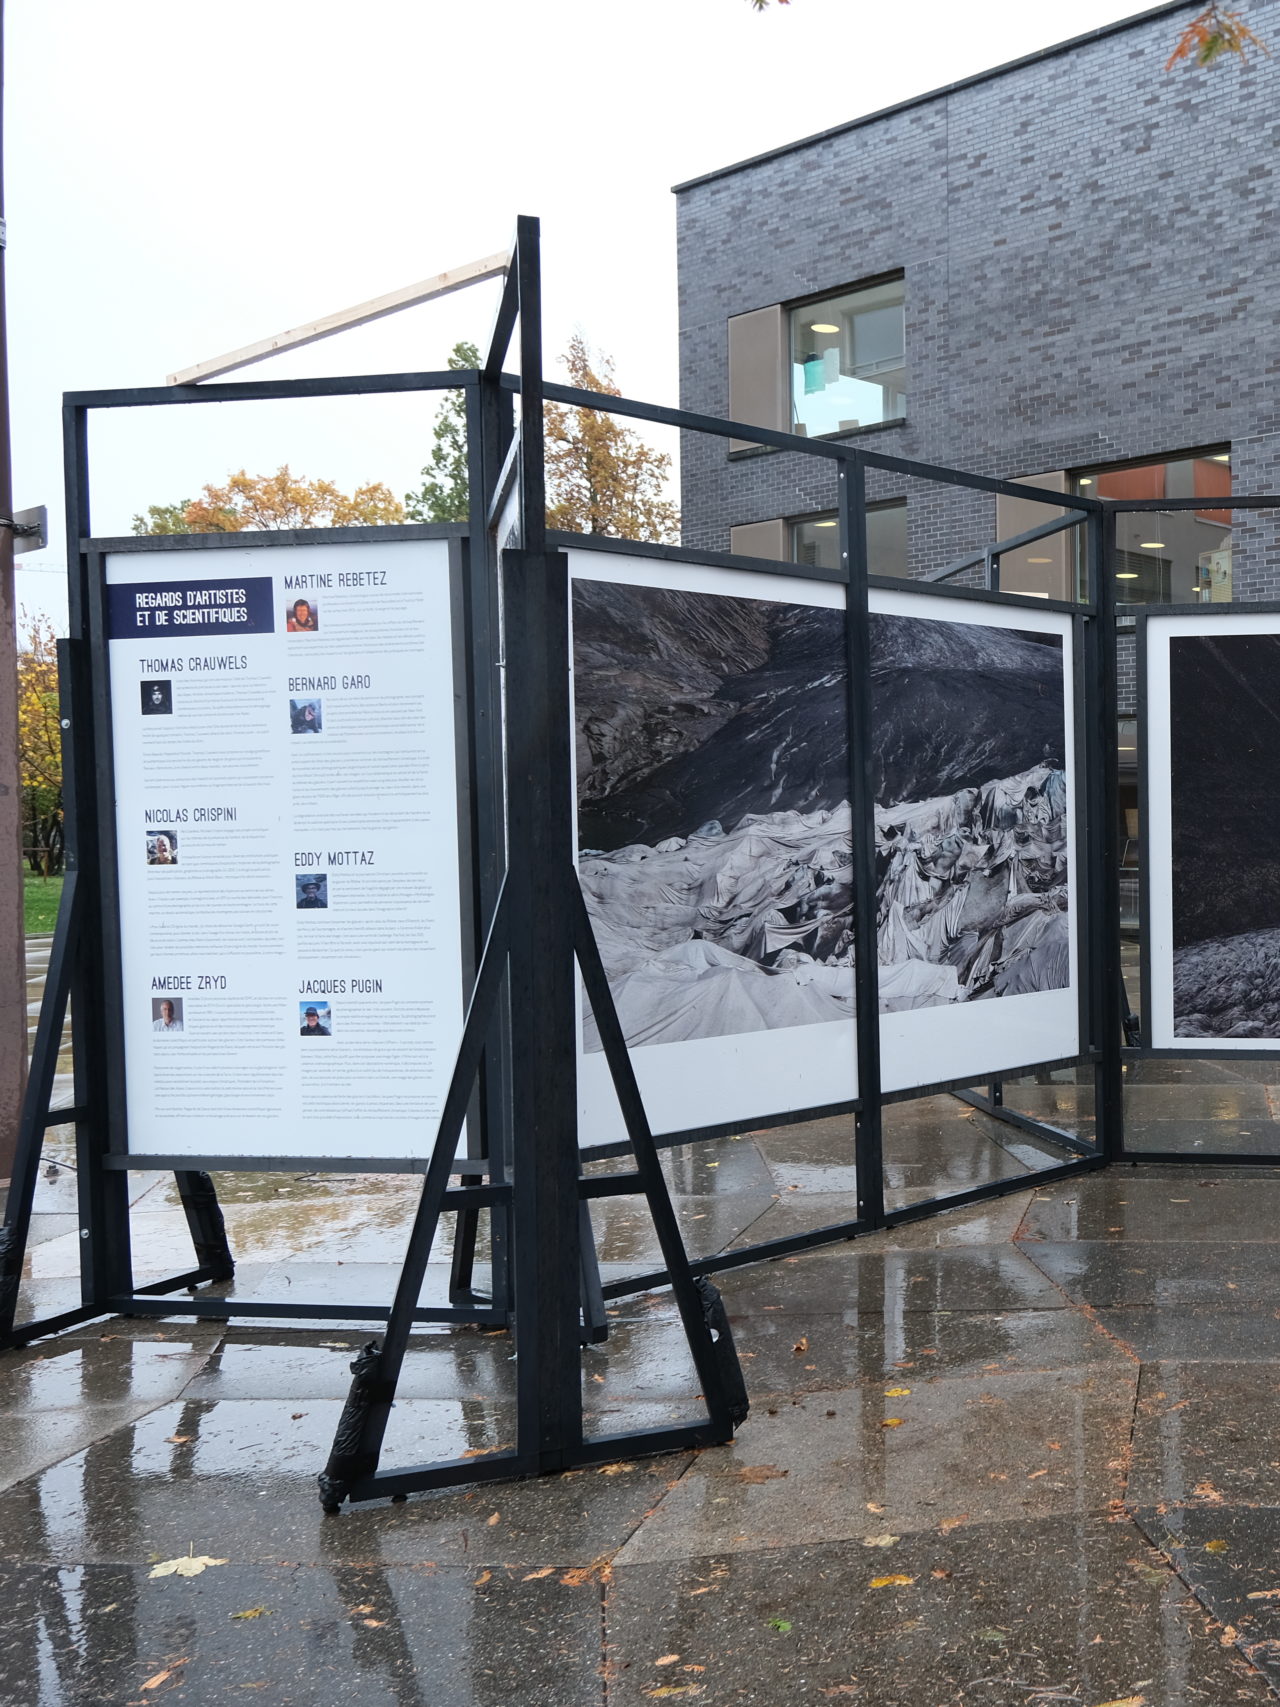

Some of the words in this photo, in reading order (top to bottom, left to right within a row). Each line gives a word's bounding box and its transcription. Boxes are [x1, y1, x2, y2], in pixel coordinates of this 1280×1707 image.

[284, 573, 334, 590] MARTINE
[338, 570, 387, 587] REBETEZ
[135, 591, 183, 608] REGARDS
[186, 588, 247, 606] D'ARTISTES
[136, 610, 151, 627] ET
[155, 610, 169, 626] DE
[173, 607, 248, 625] SCIENTIFIQUES
[139, 657, 184, 673] THOMAS
[188, 655, 248, 671] CRAUWELS
[288, 676, 337, 692] BERNARD
[342, 674, 371, 690] GARO
[144, 808, 189, 824] NICOLAS
[193, 807, 237, 822] CRISPINI
[294, 852, 322, 867] EDDY
[327, 850, 375, 866] MOTTAZ
[151, 975, 192, 991] AMEDEE
[197, 975, 227, 990] ZRYD
[298, 979, 346, 995] JACQUES
[351, 979, 383, 994] PUGIN
